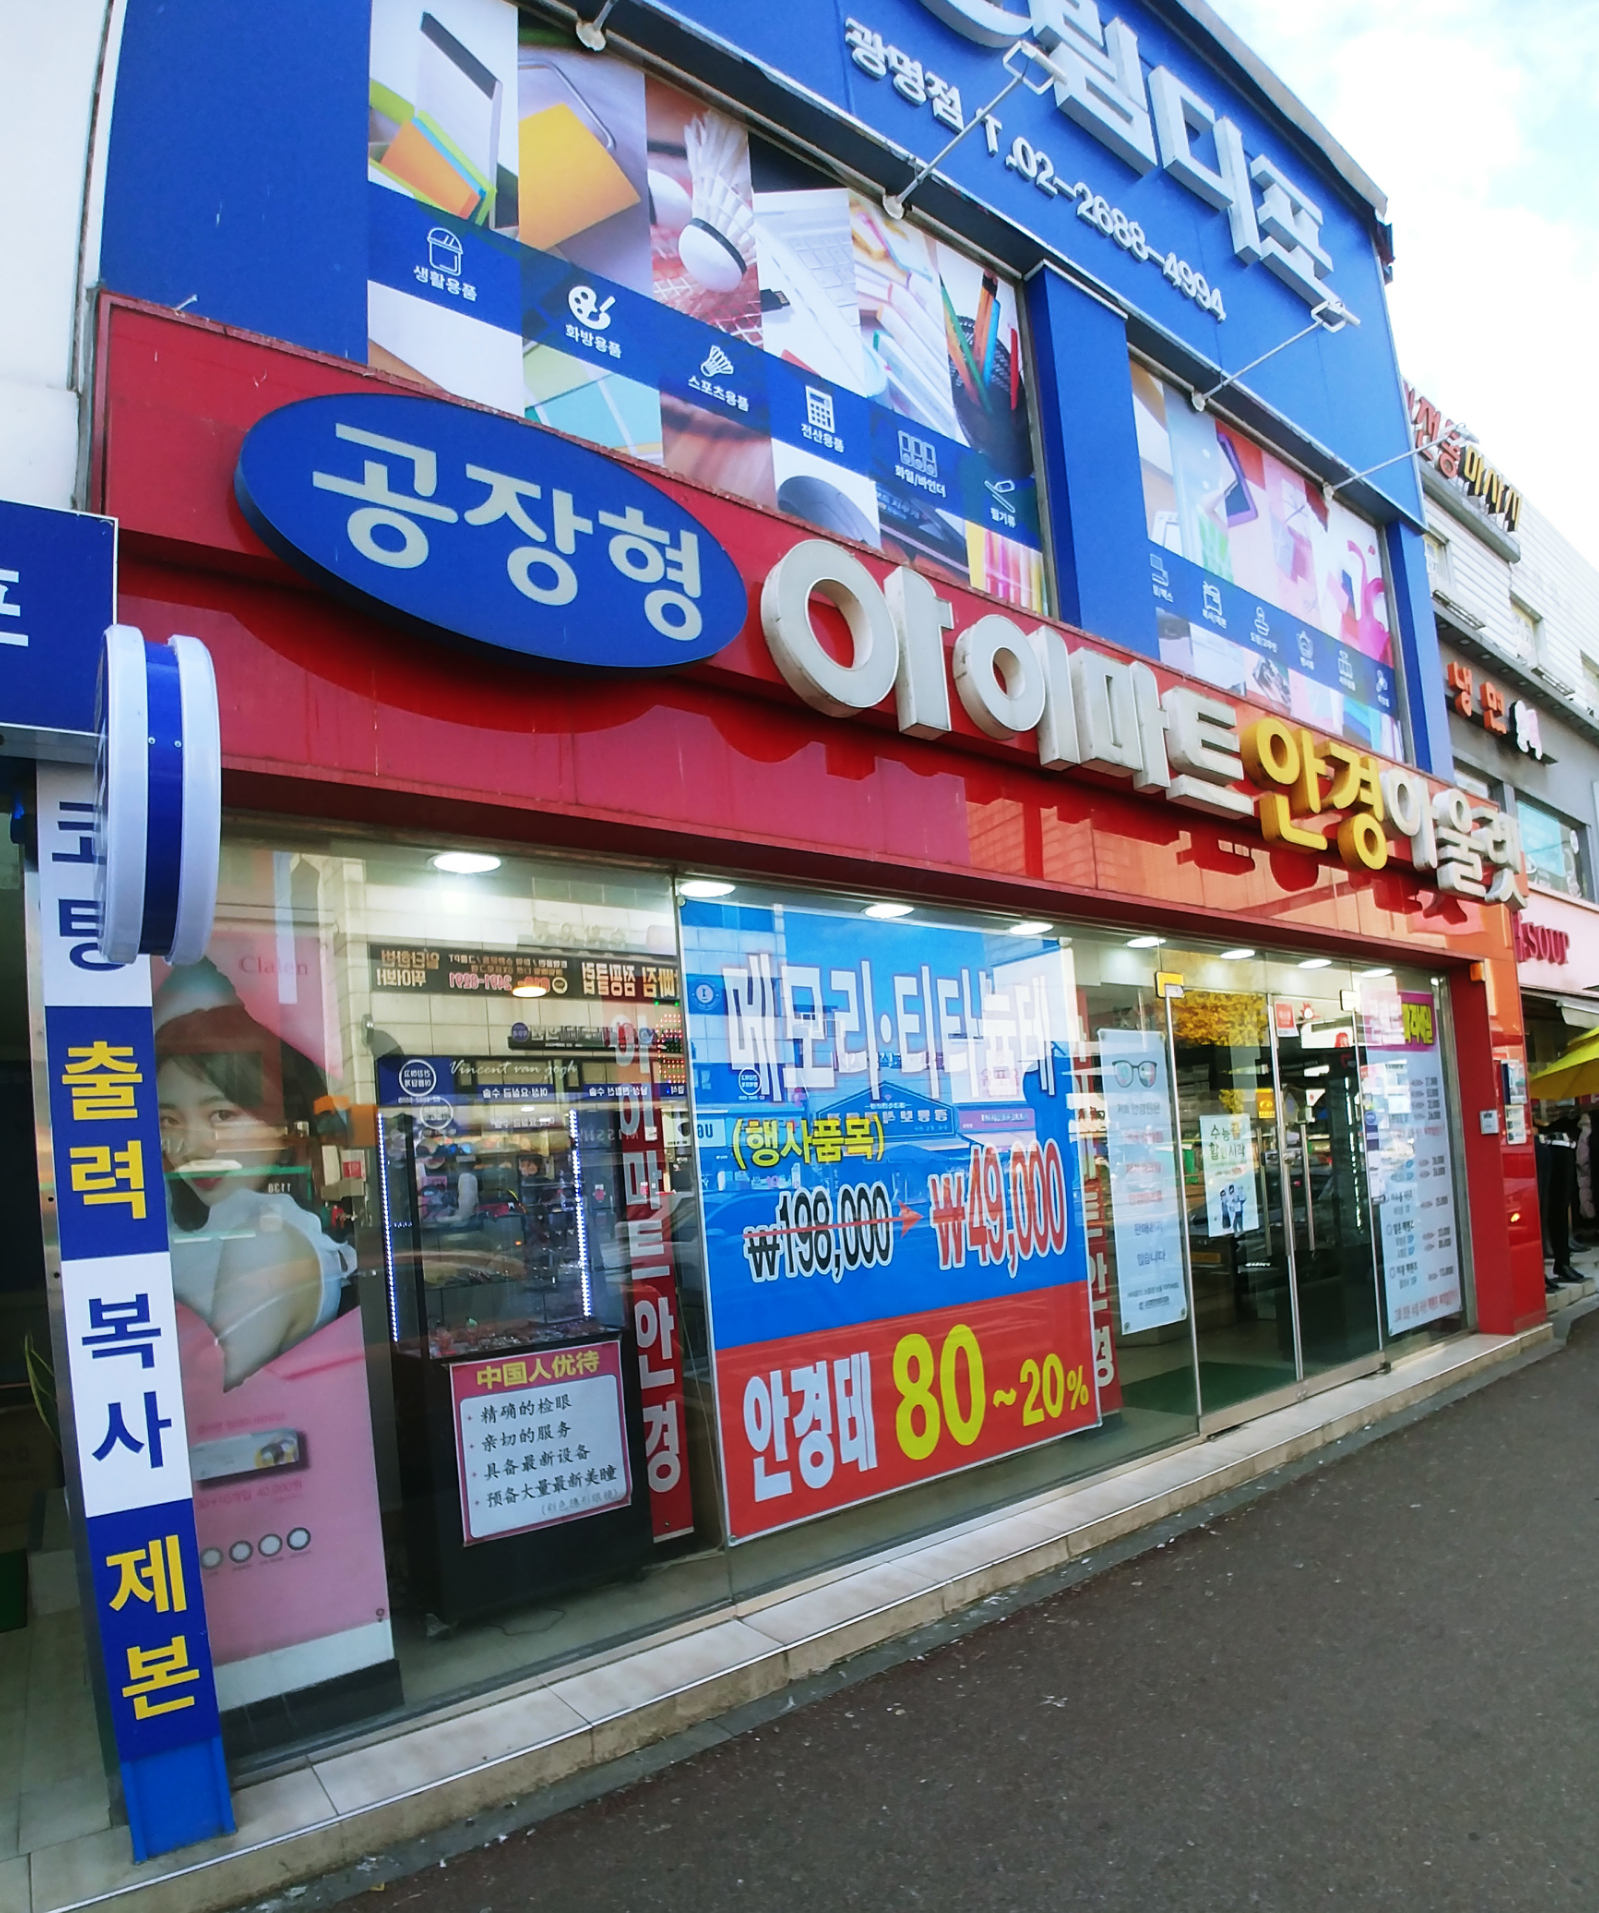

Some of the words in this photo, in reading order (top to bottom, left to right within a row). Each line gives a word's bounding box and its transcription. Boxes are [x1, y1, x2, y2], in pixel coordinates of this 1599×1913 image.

[845, 17, 964, 133] 광명점
[413, 262, 478, 302] 생활용품
[565, 323, 622, 360] 화방용품
[687, 374, 750, 412] 스포츠용품
[801, 423, 845, 454] 전산용품
[895, 465, 947, 498] 화일/바인더
[312, 422, 706, 642] 공장형
[1447, 661, 1508, 735] 냉면
[238, 956, 308, 976] Claen
[513, 1065, 542, 1074] van
[62, 1041, 147, 1220] 출력
[732, 1112, 885, 1170] (행사품목)
[82, 1293, 172, 1469] 복사
[476, 1350, 600, 1390] 中国人优待
[480, 1393, 572, 1424] 精确的检眼
[743, 1351, 878, 1502] 안경테
[481, 1421, 572, 1453] 亲切的服务
[484, 1443, 591, 1481] 具备最新设备
[106, 1534, 200, 1722] 제본
